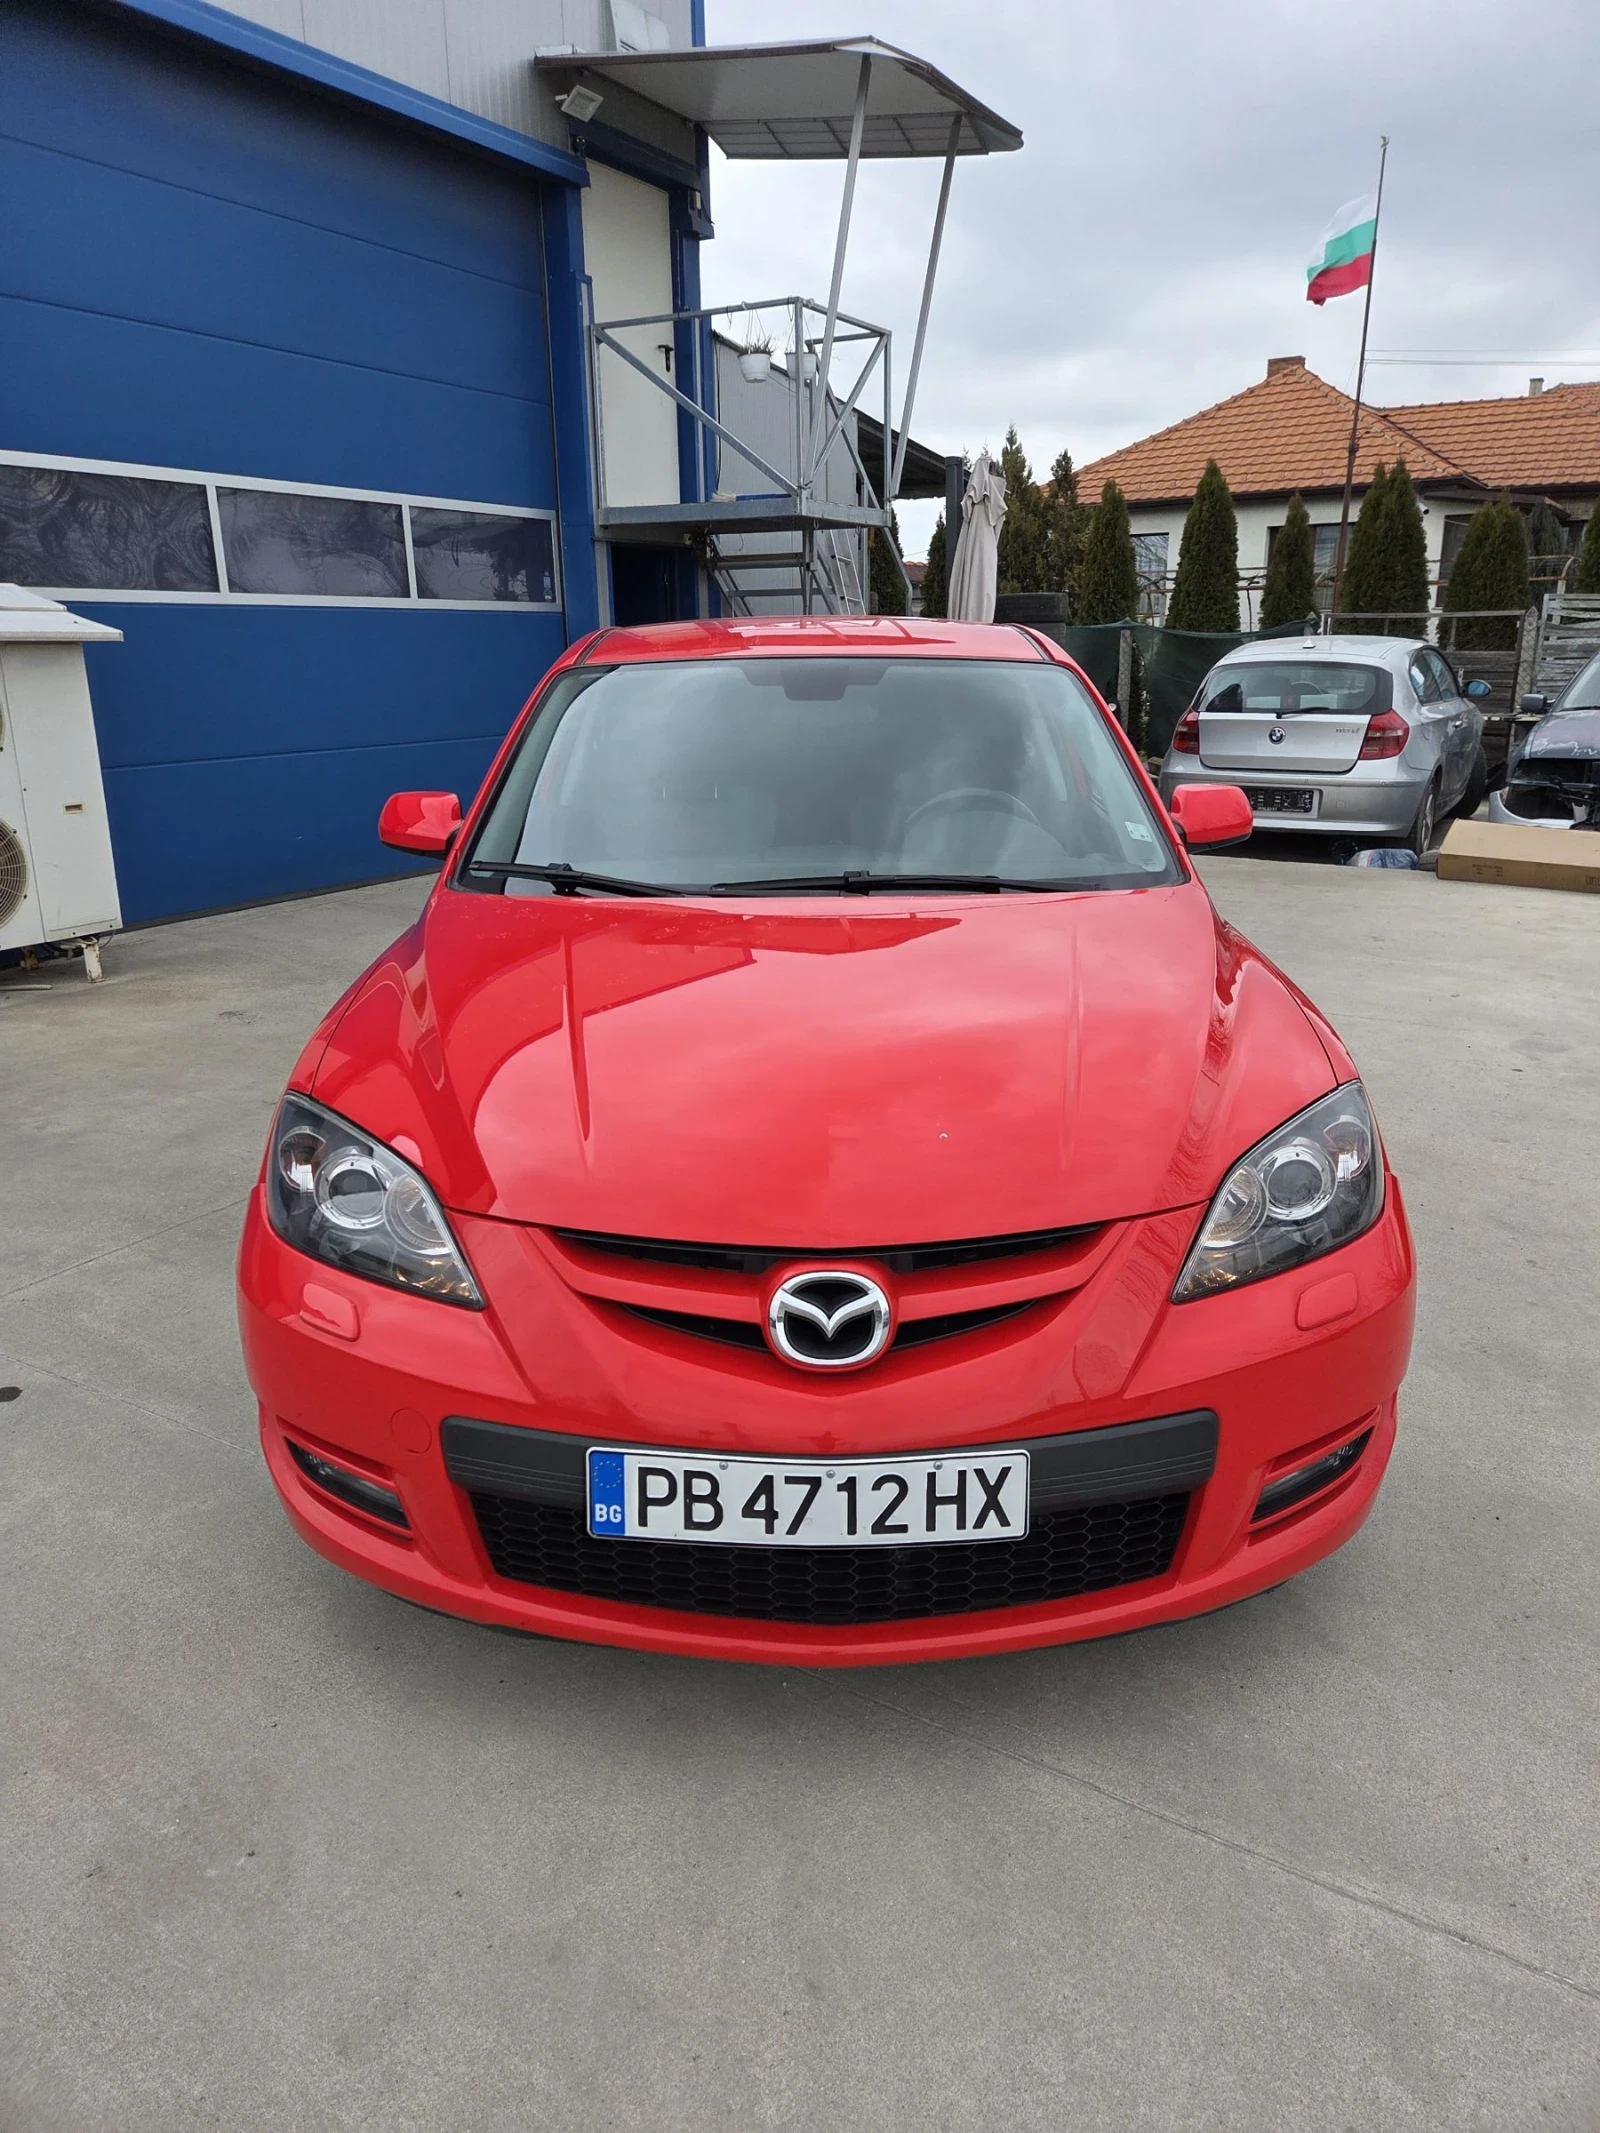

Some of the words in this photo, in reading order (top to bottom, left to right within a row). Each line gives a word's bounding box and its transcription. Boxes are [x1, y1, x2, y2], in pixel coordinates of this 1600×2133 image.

[594, 1503, 622, 1523] BG
[637, 1466, 724, 1531] PB
[741, 1474, 909, 1536] 4712
[925, 1466, 1012, 1532] HX
